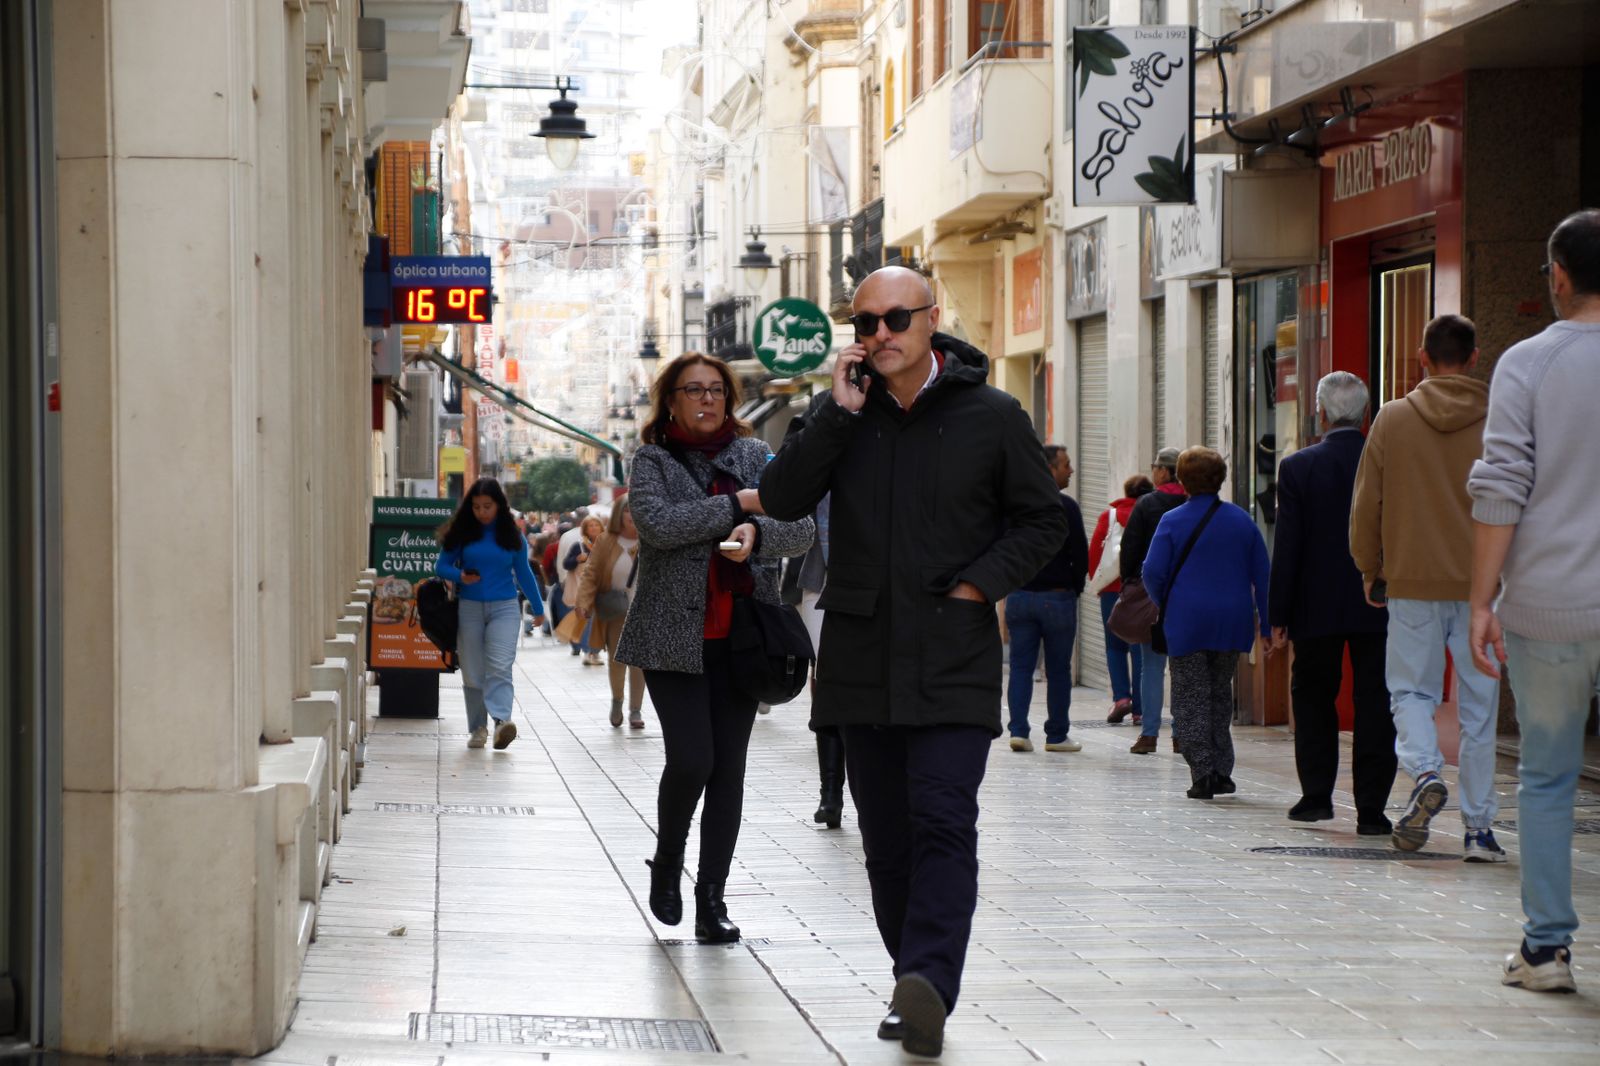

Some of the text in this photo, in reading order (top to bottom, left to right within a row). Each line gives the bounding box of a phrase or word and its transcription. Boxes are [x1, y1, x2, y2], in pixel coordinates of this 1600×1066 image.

[1134, 30, 1187, 40] Desde 1992
[1381, 122, 1432, 188] PRIETO
[394, 263, 487, 279] óptica urbano
[408, 289, 434, 321] 16
[377, 506, 452, 516] NUEVOS SABORES
[385, 551, 421, 560] FELICES
